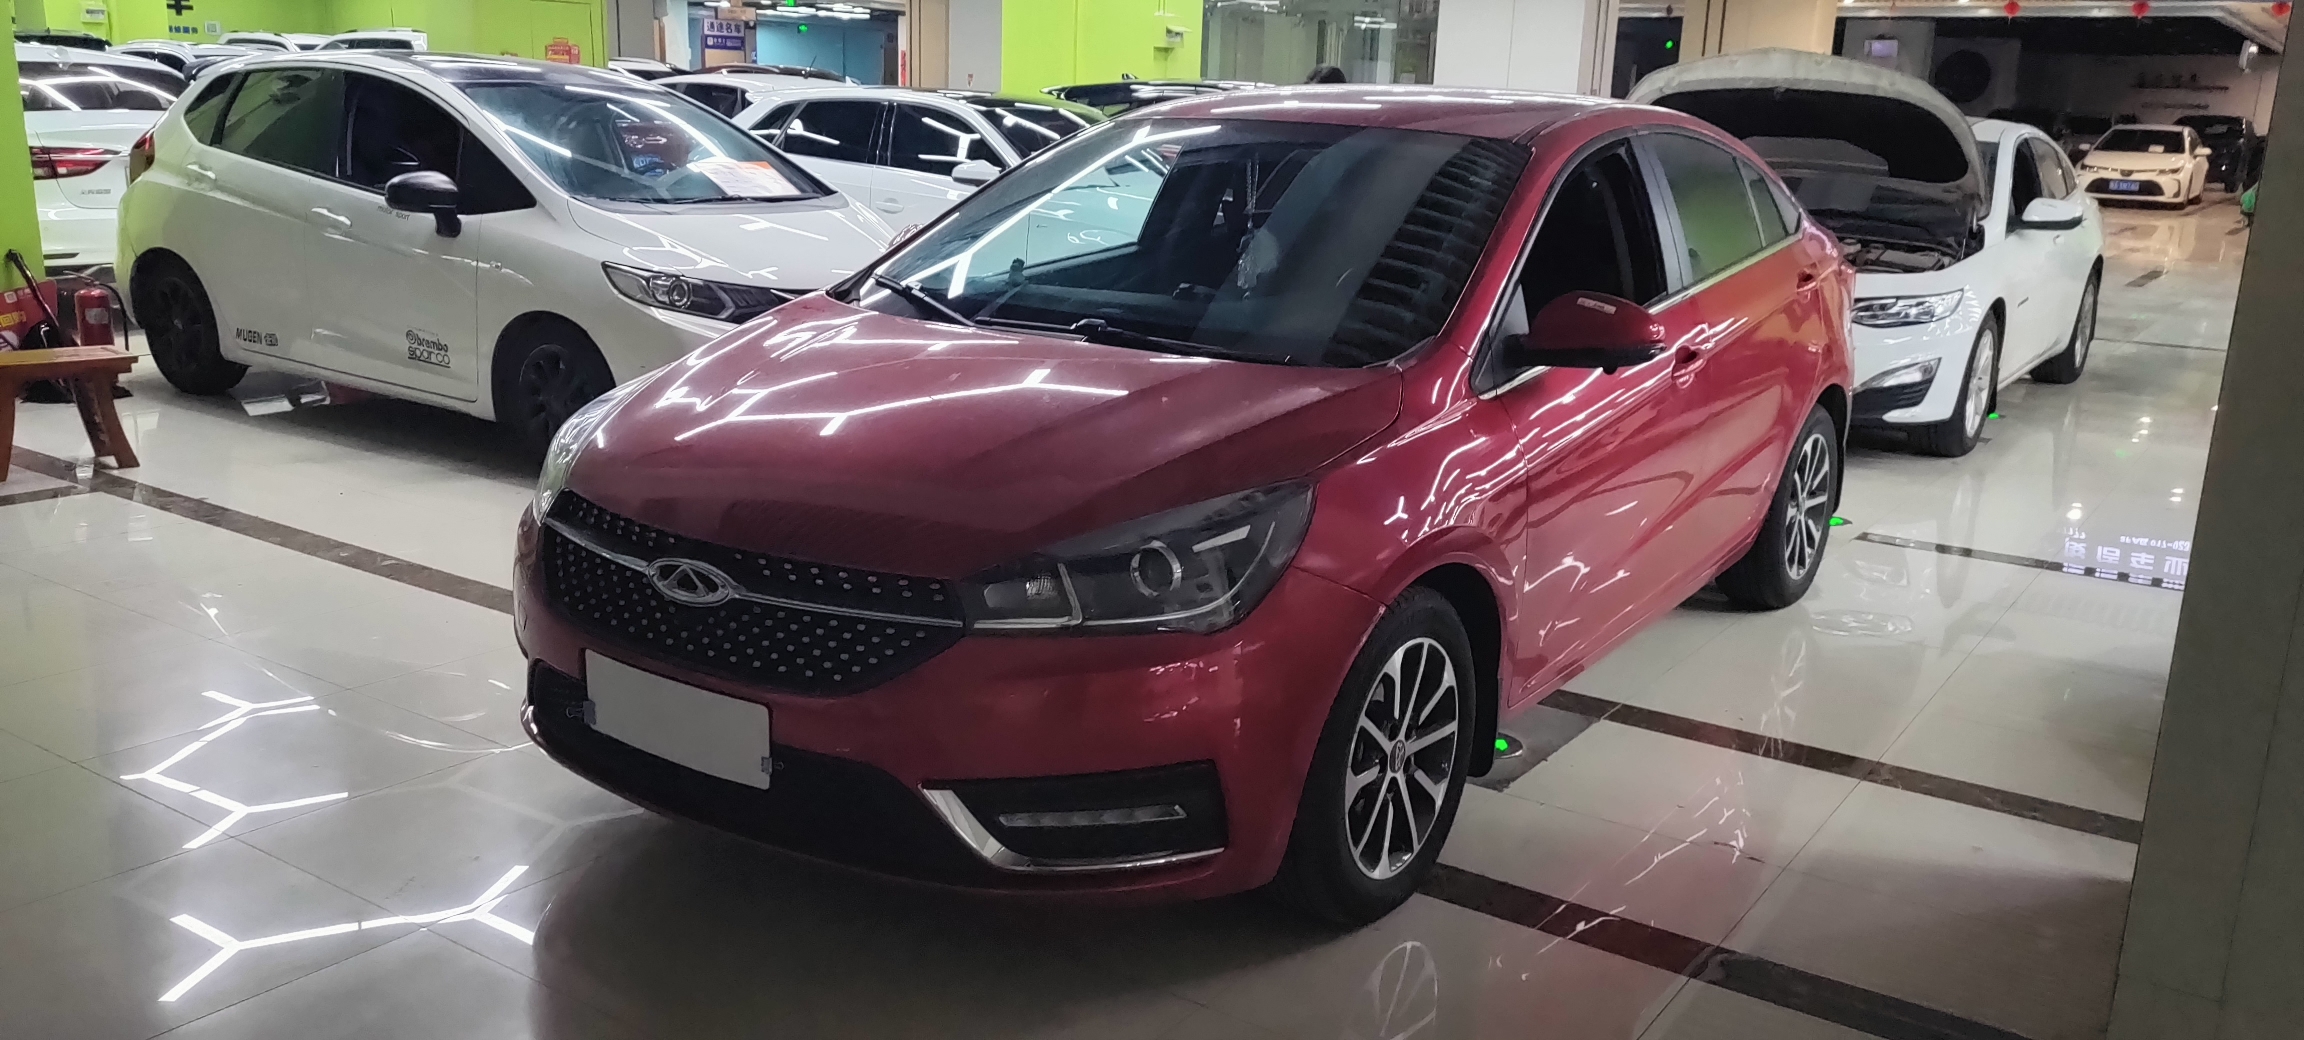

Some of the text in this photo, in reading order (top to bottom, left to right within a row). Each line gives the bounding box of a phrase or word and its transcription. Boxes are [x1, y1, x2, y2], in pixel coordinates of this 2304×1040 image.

[236, 328, 262, 344] MUGEN
[414, 331, 448, 352] brembo
[408, 346, 450, 365] sparco
